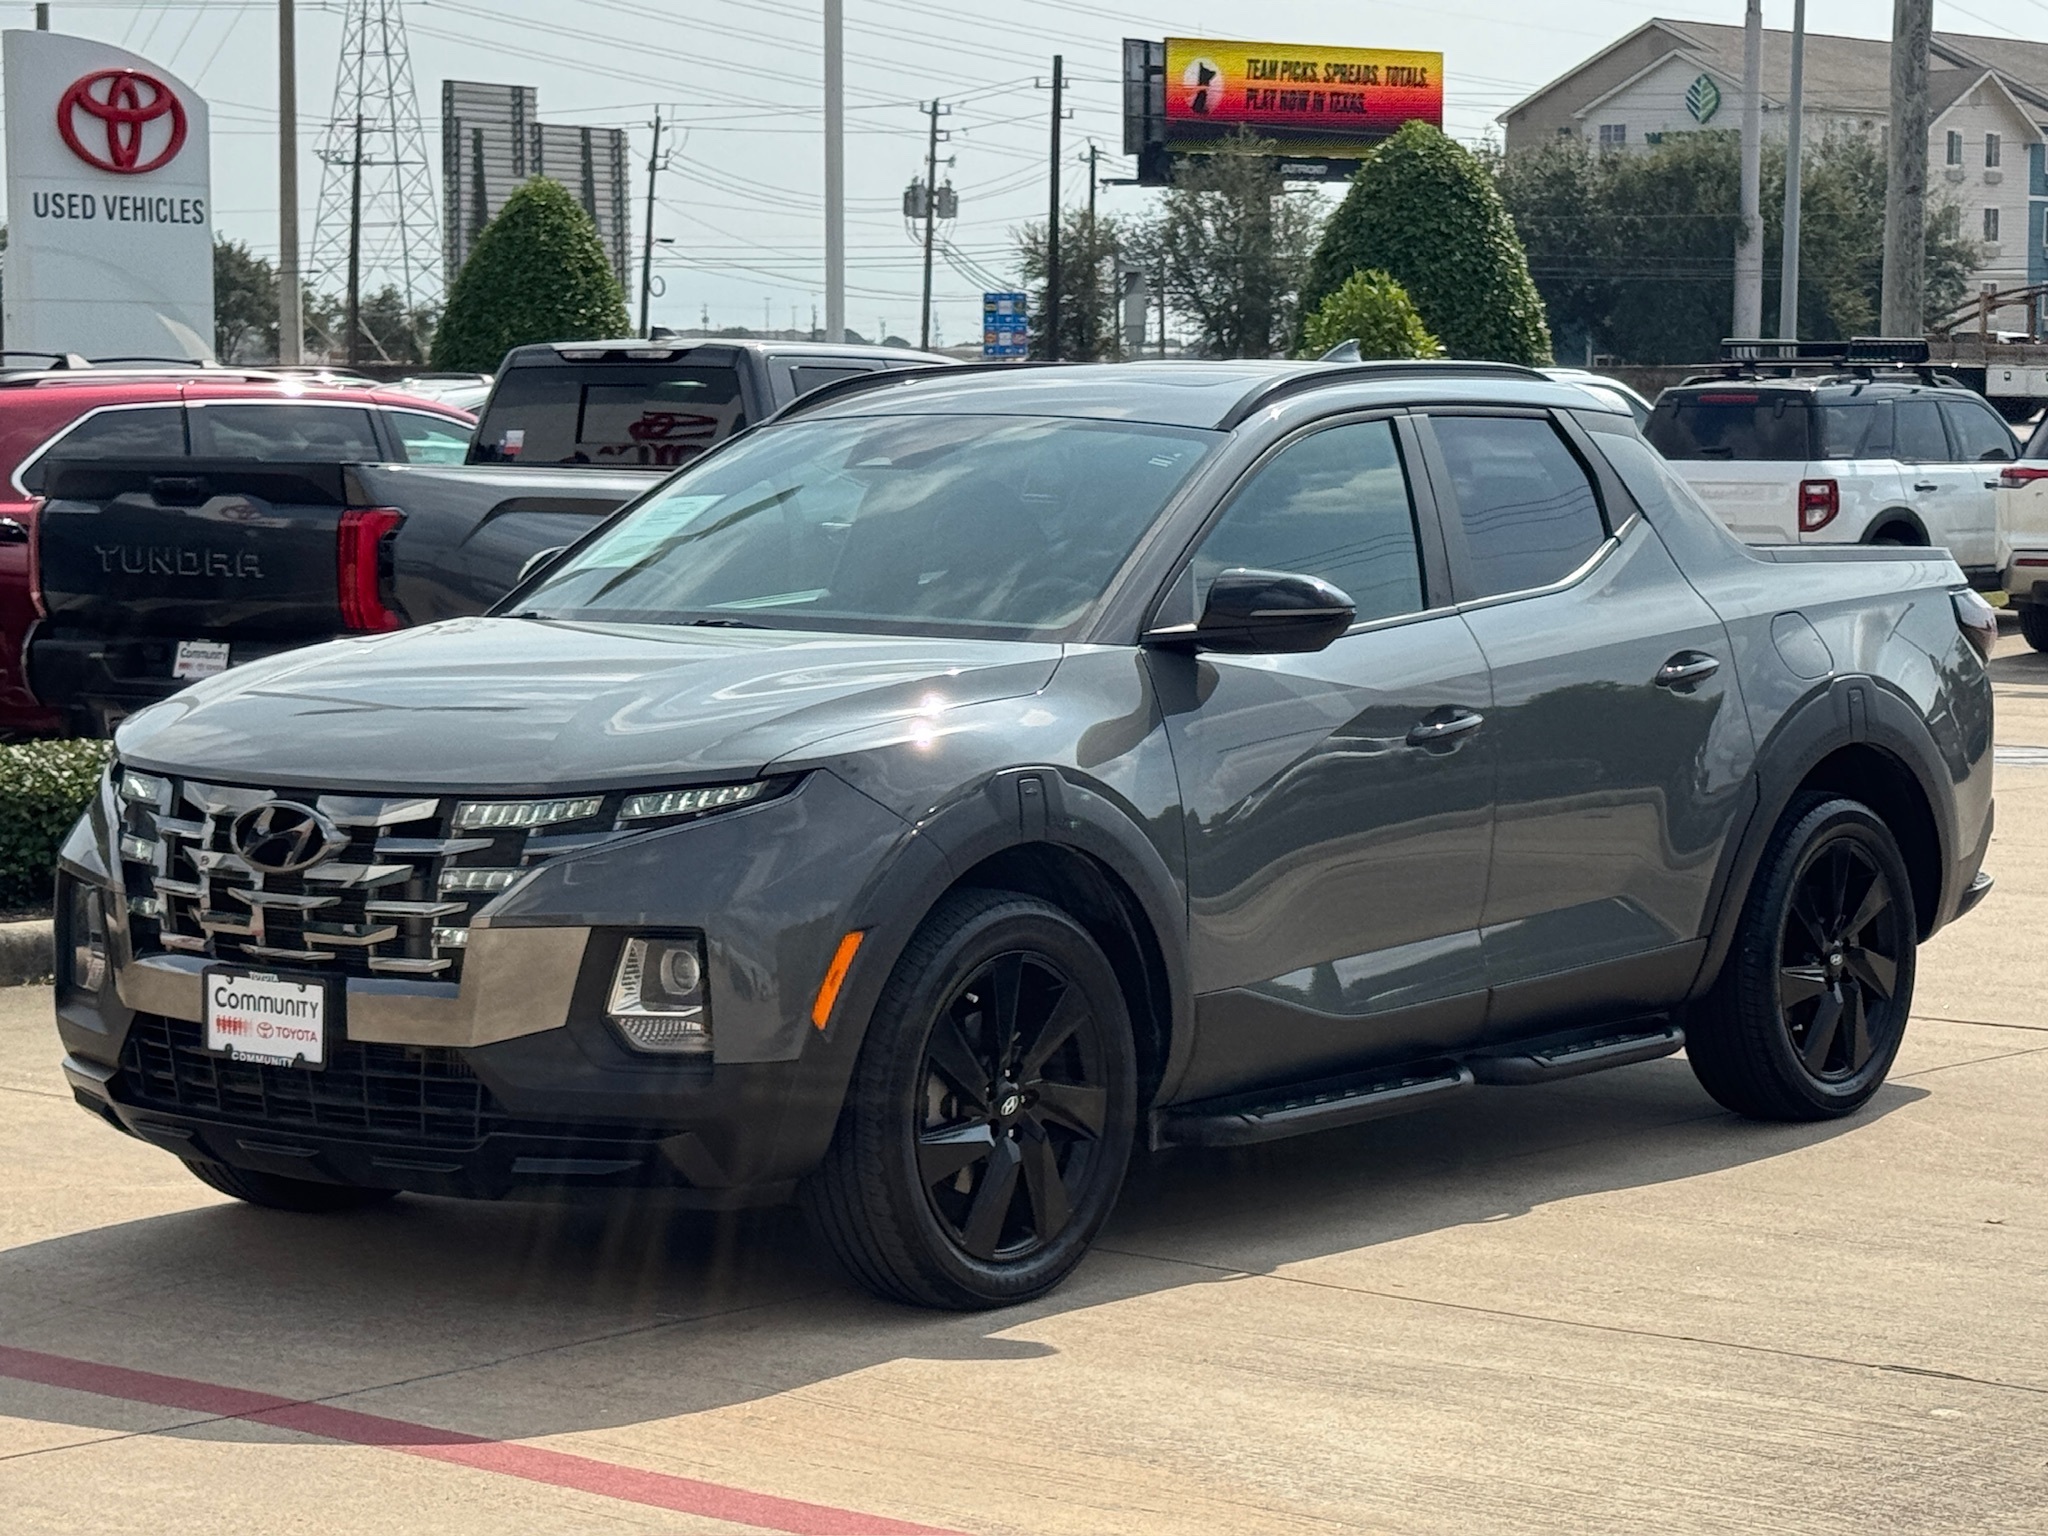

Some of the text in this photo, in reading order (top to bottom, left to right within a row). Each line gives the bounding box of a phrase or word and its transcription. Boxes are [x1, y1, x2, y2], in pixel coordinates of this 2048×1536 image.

[1246, 58, 1428, 87] TEAM PICKS. SPREADS. TOTALS.
[1246, 88, 1367, 114] PLAY NOW IN TEXAS.
[33, 192, 205, 225] USED VEHICLES
[94, 545, 265, 578] TUNDRA
[275, 1026, 318, 1042] TOYOTA
[231, 1051, 292, 1068] COMMUNITY
